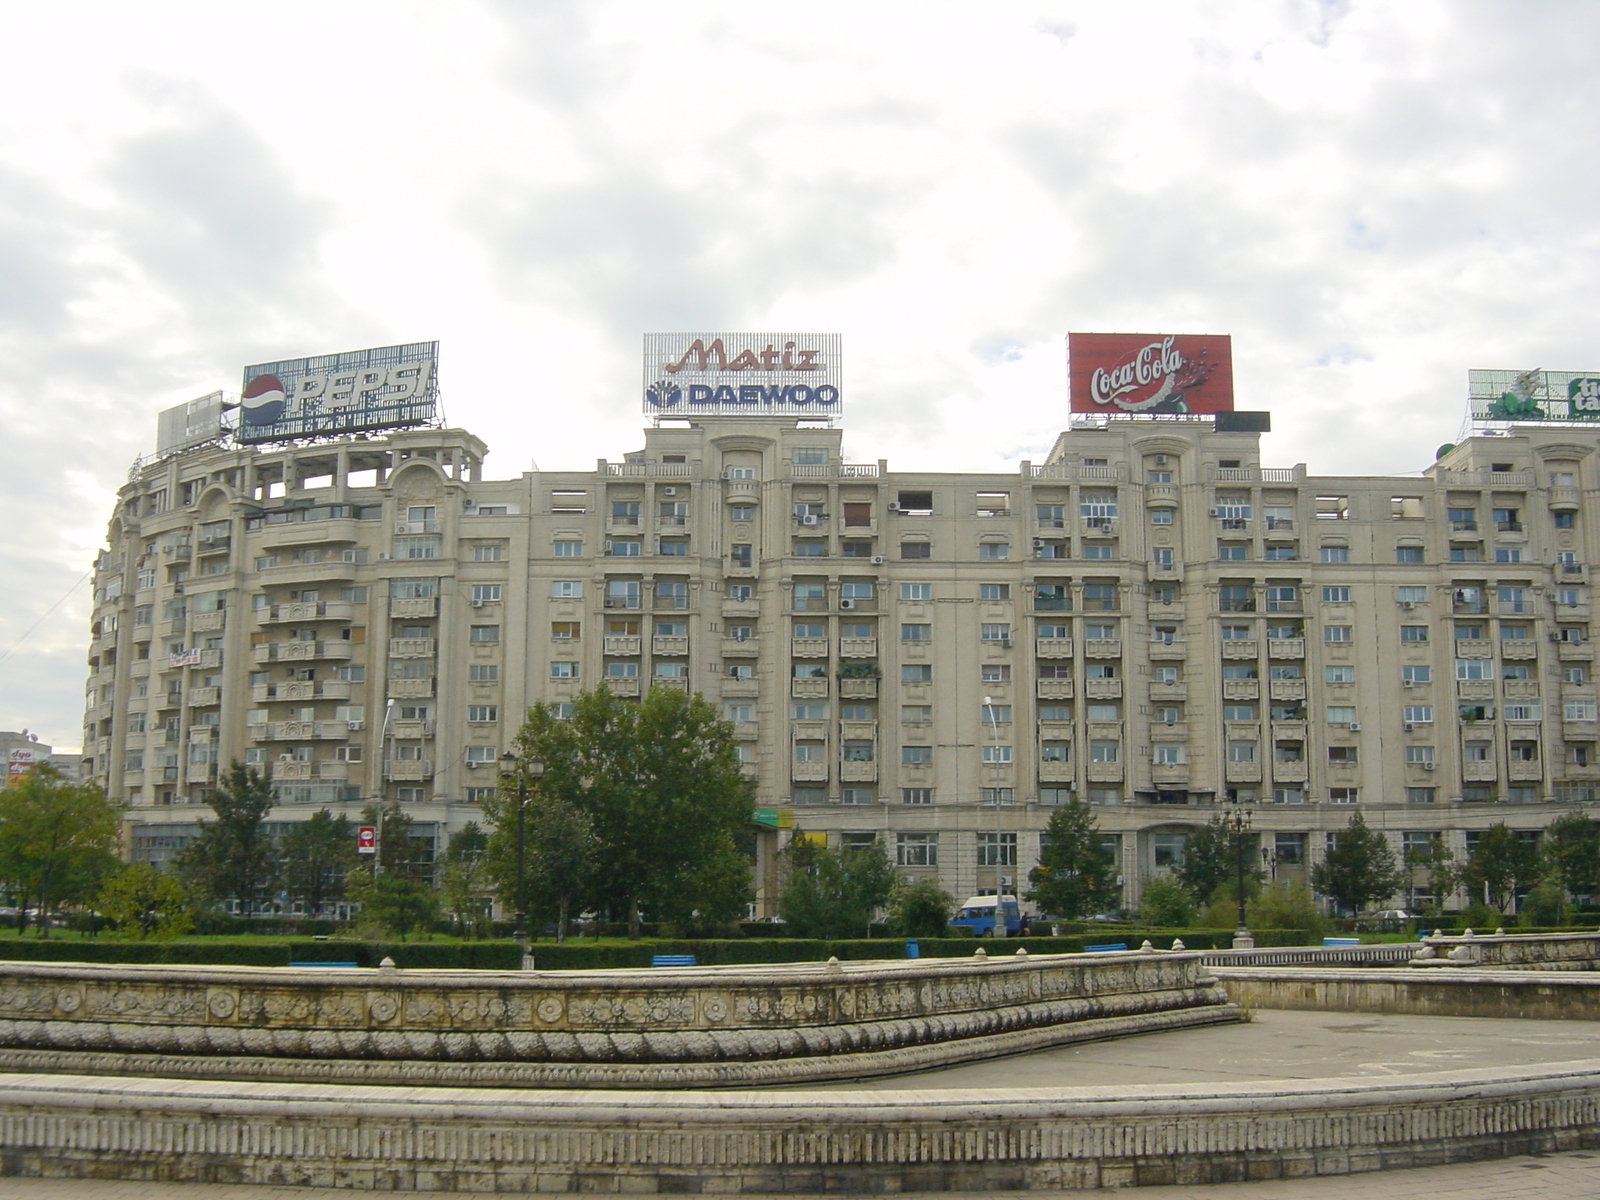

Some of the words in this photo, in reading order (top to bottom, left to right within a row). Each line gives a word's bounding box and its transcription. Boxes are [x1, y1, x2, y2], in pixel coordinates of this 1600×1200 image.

[665, 338, 820, 373] Matiz
[1090, 335, 1183, 404] Coca-Cola
[290, 359, 435, 413] PEPSI
[688, 384, 839, 406] DAEWOO
[1577, 378, 1600, 397] ti
[1571, 391, 1600, 411] ta
[11, 750, 31, 760] dyo
